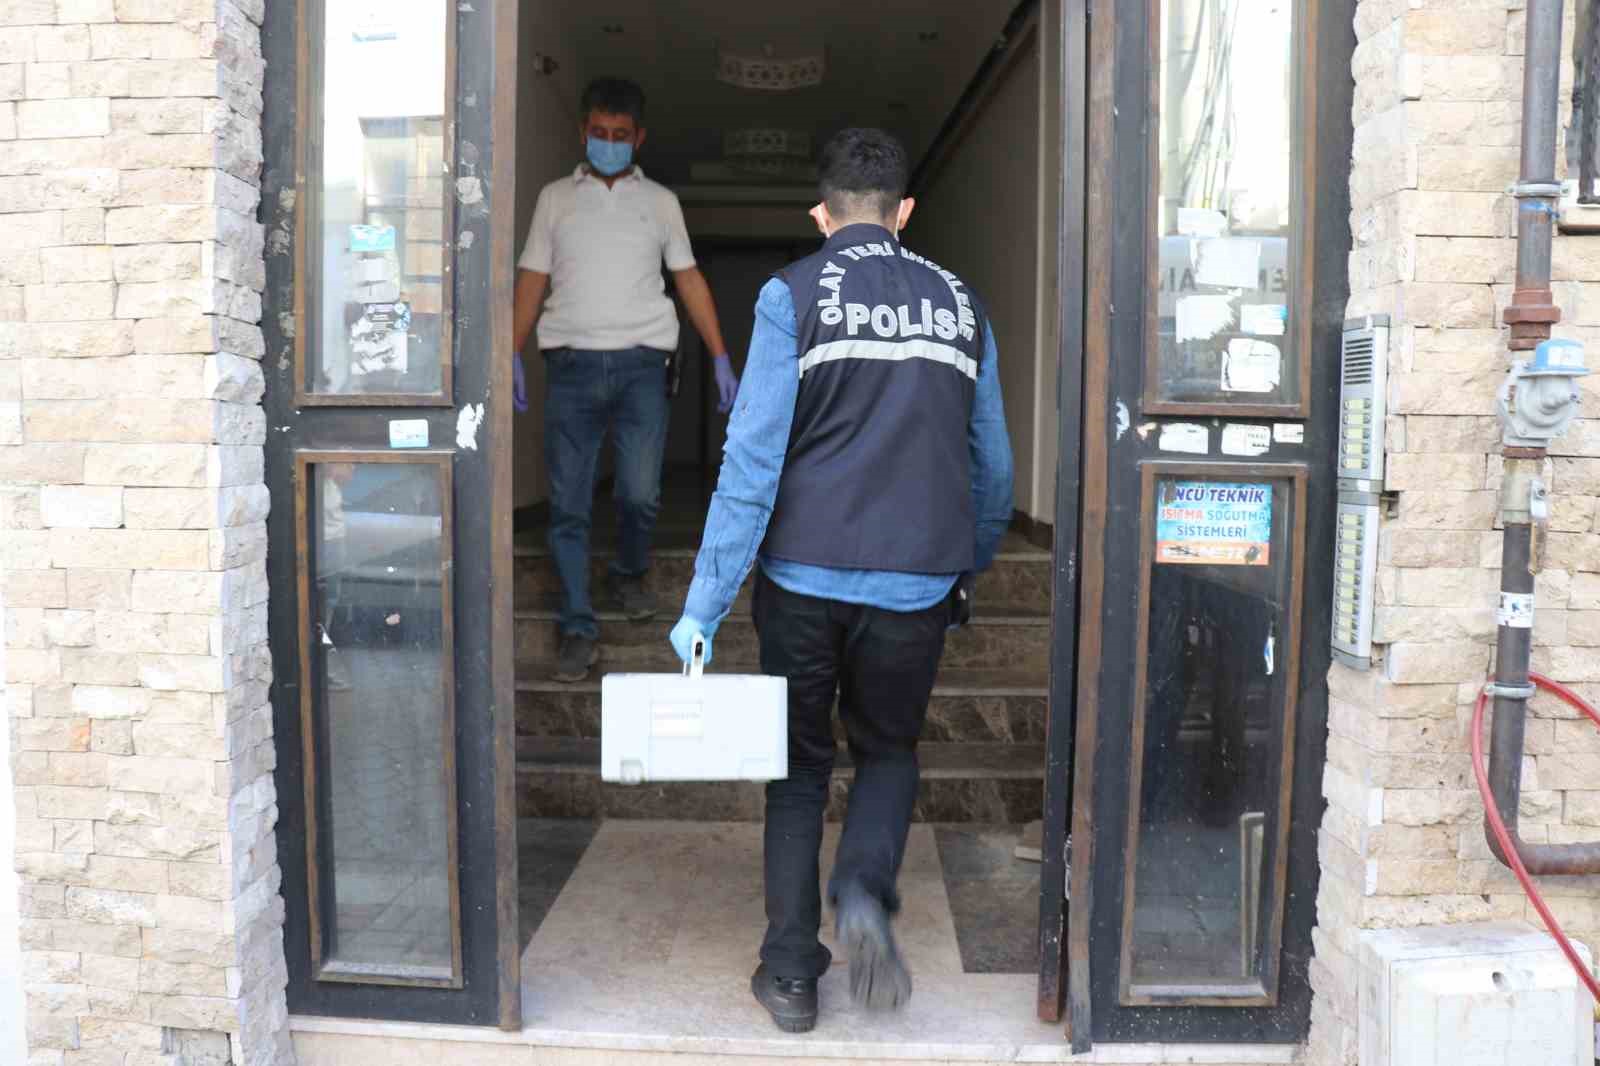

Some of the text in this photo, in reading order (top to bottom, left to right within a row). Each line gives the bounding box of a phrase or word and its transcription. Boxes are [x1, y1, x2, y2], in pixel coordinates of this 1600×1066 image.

[817, 261, 846, 325] OLAY
[837, 241, 895, 260] YERİ
[845, 298, 958, 340] POLİS
[1173, 484, 1265, 503] NCÜ TEKNİK
[1177, 524, 1247, 537] SİSTEMLERİ
